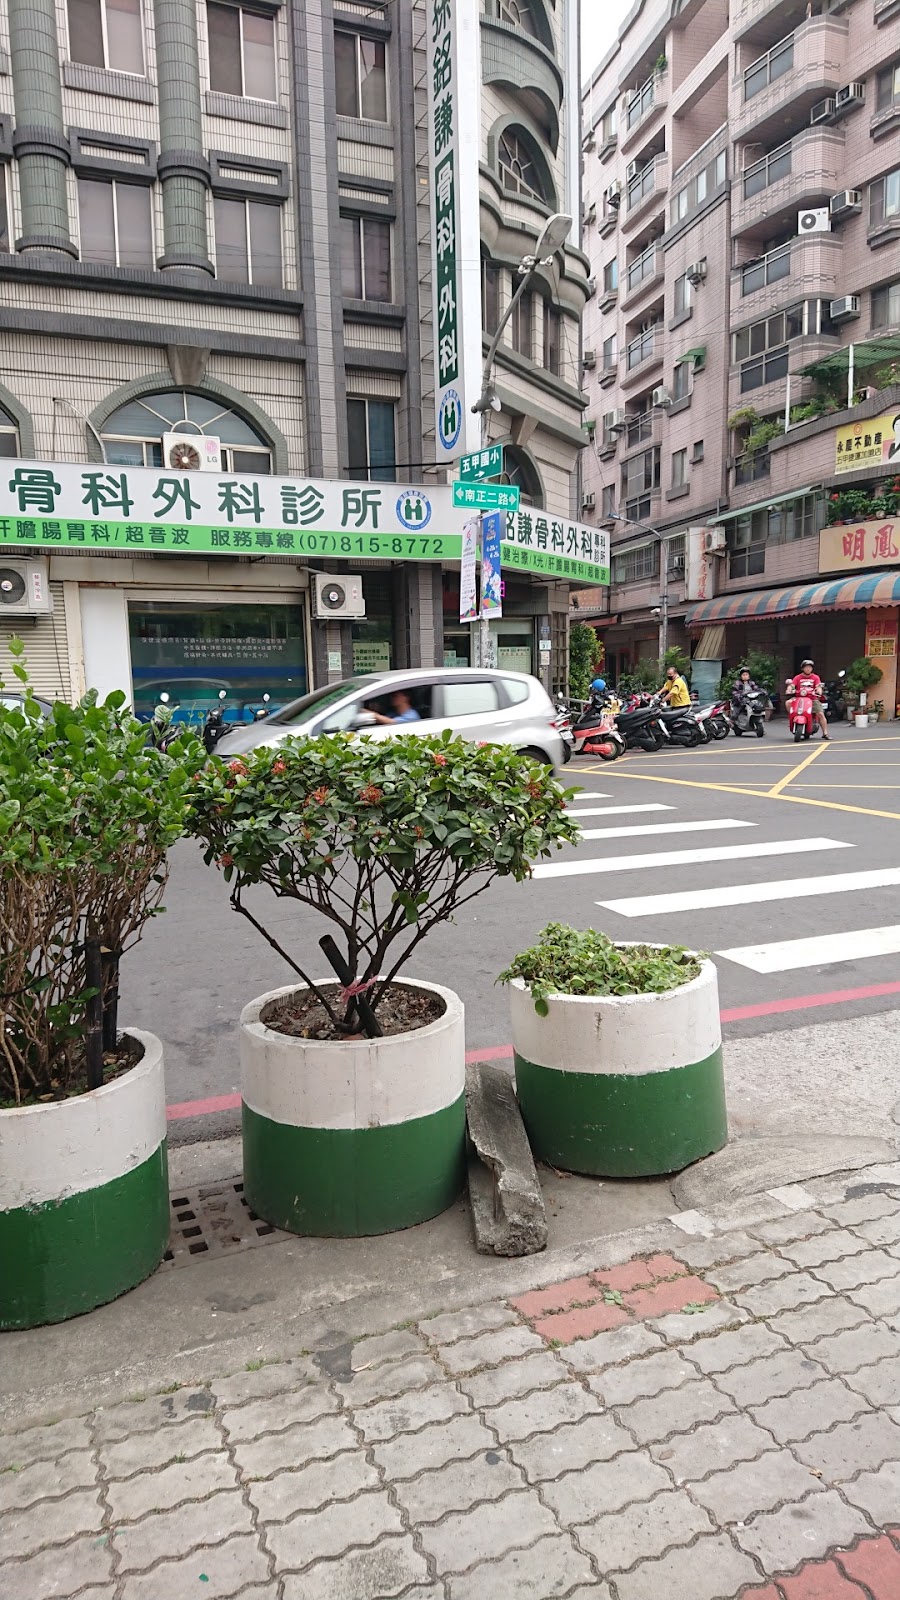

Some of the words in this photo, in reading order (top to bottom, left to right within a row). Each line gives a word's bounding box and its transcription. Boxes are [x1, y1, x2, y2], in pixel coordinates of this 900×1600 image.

[462, 449, 499, 473] 五甲國小
[8, 467, 382, 530] 骨科外科診所
[464, 488, 509, 506] 南正二路
